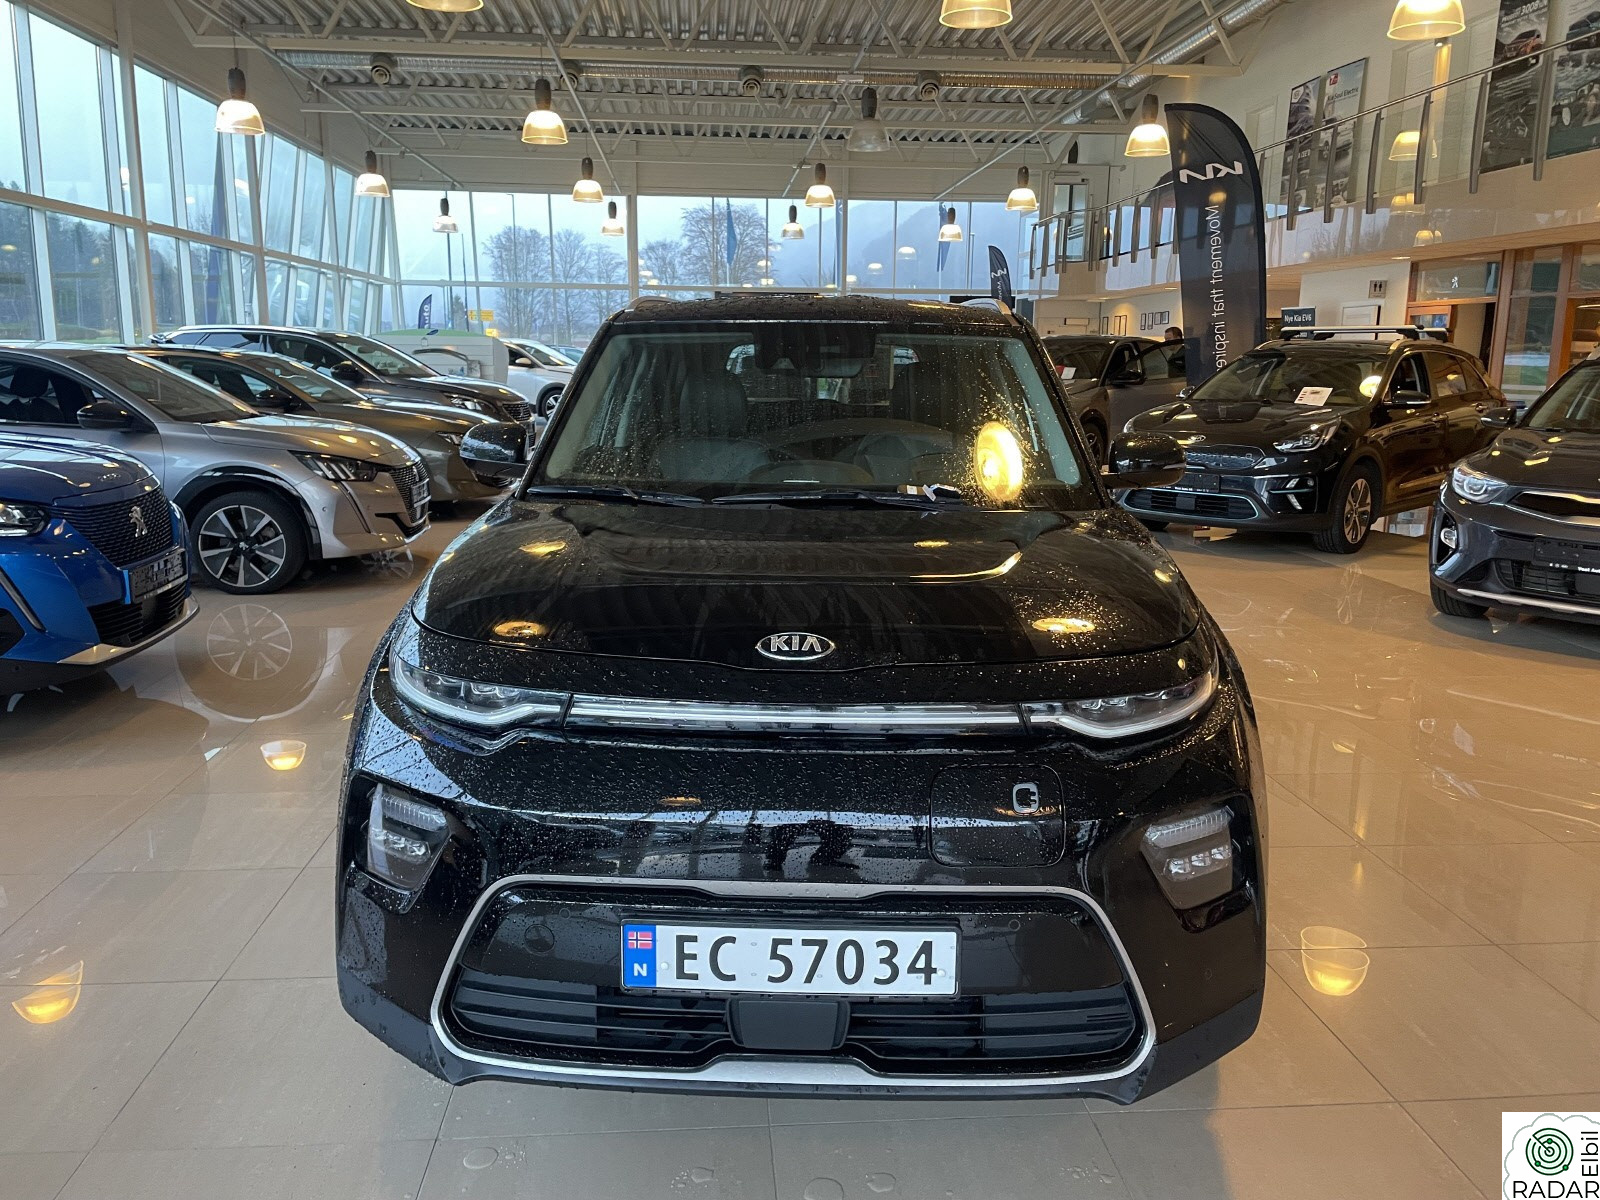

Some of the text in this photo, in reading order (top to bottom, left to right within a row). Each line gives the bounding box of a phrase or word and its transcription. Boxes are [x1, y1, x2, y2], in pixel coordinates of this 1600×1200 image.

[770, 635, 822, 652] KIA
[675, 934, 938, 986] EC 57034
[633, 963, 647, 977] N
